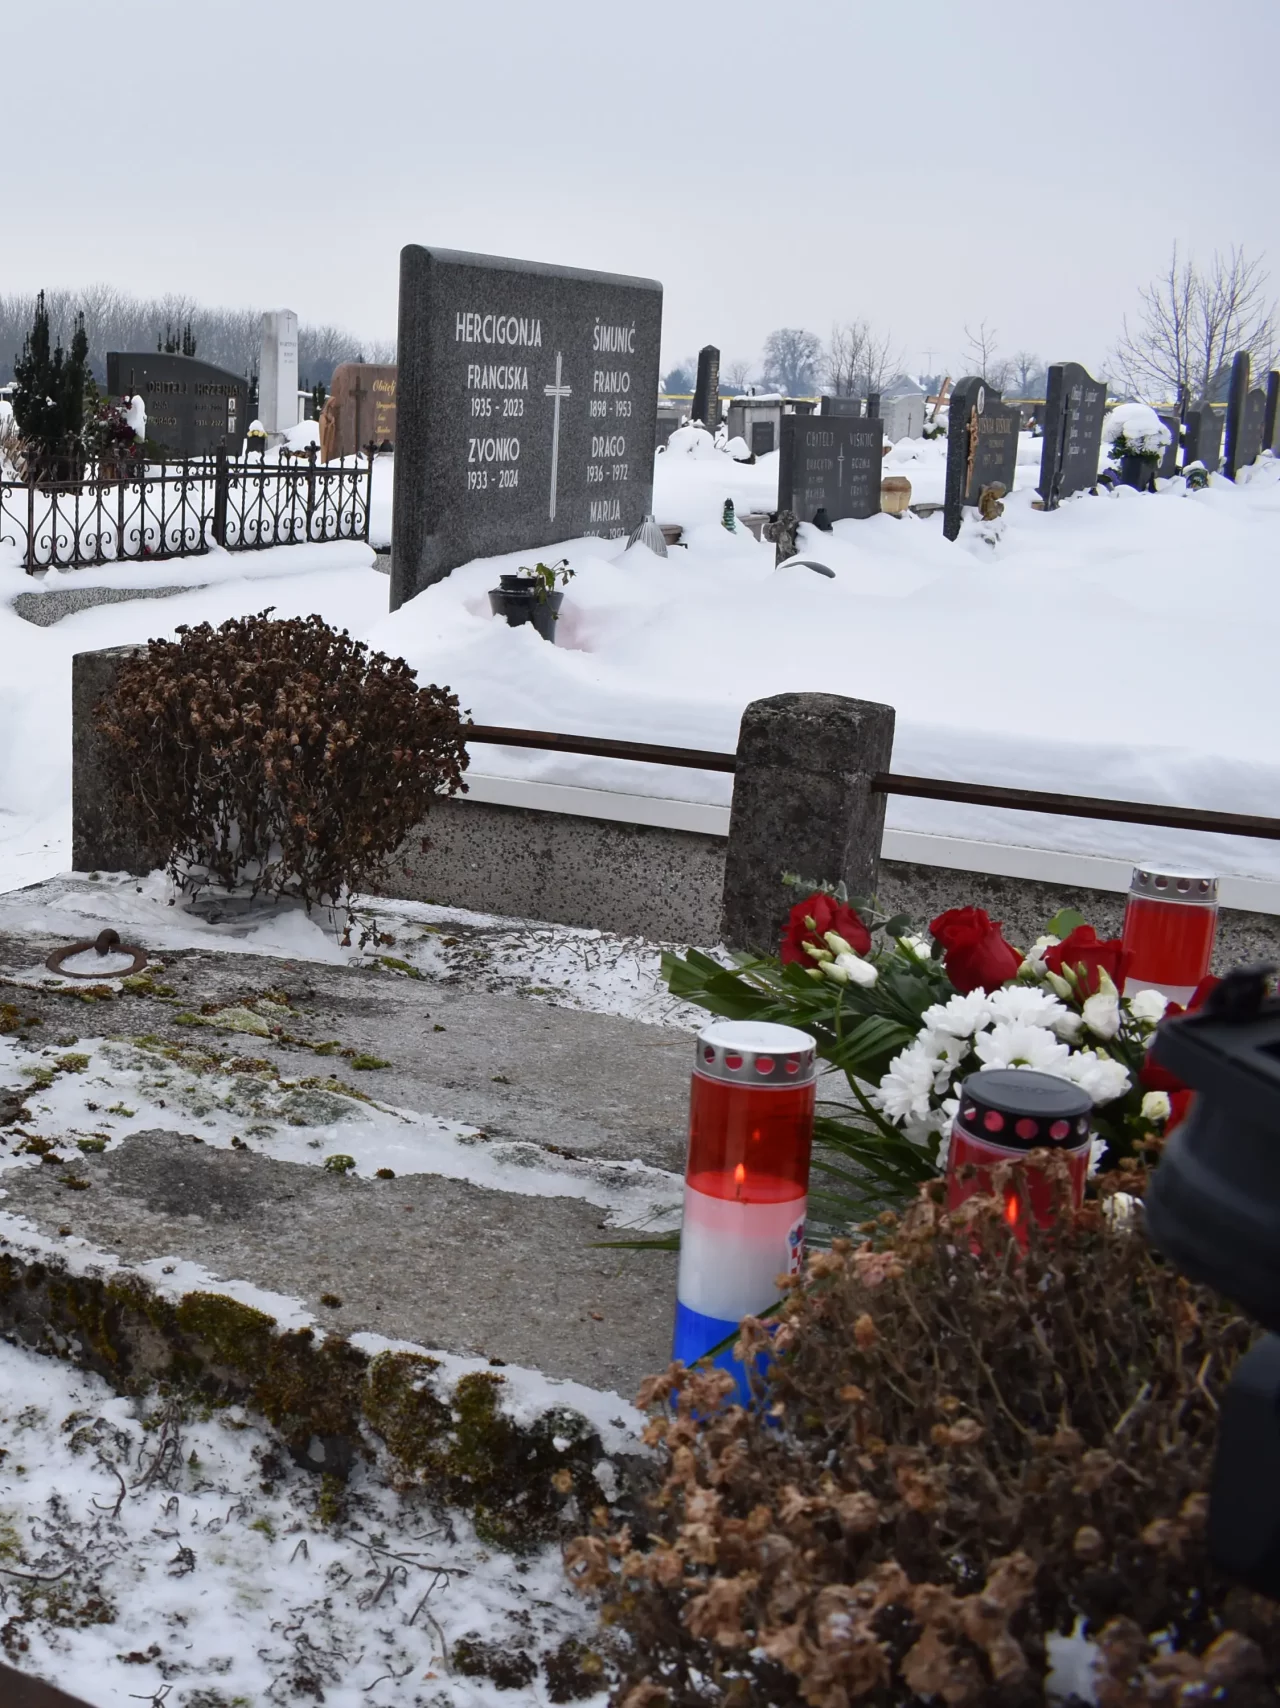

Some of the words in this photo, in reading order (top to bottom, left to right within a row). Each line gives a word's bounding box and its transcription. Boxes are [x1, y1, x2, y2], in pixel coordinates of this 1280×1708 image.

[456, 311, 542, 347] HERCIGONJA
[593, 316, 635, 353] ŠIMUNIĆ
[148, 381, 188, 395] OBITELJ
[467, 364, 528, 390] FRANCISKA
[593, 370, 630, 393] FRANJO
[471, 398, 492, 416] 1935
[502, 398, 524, 417] 2023
[589, 400, 607, 417] 1898
[615, 400, 632, 417] 1953
[468, 438, 520, 462] ZVONKO
[592, 436, 625, 458] DRAGO
[467, 470, 488, 490] 1933
[498, 469, 519, 488] 2024
[587, 465, 604, 482] 1936
[612, 464, 628, 481] 1972
[590, 500, 621, 522] MARIJA
